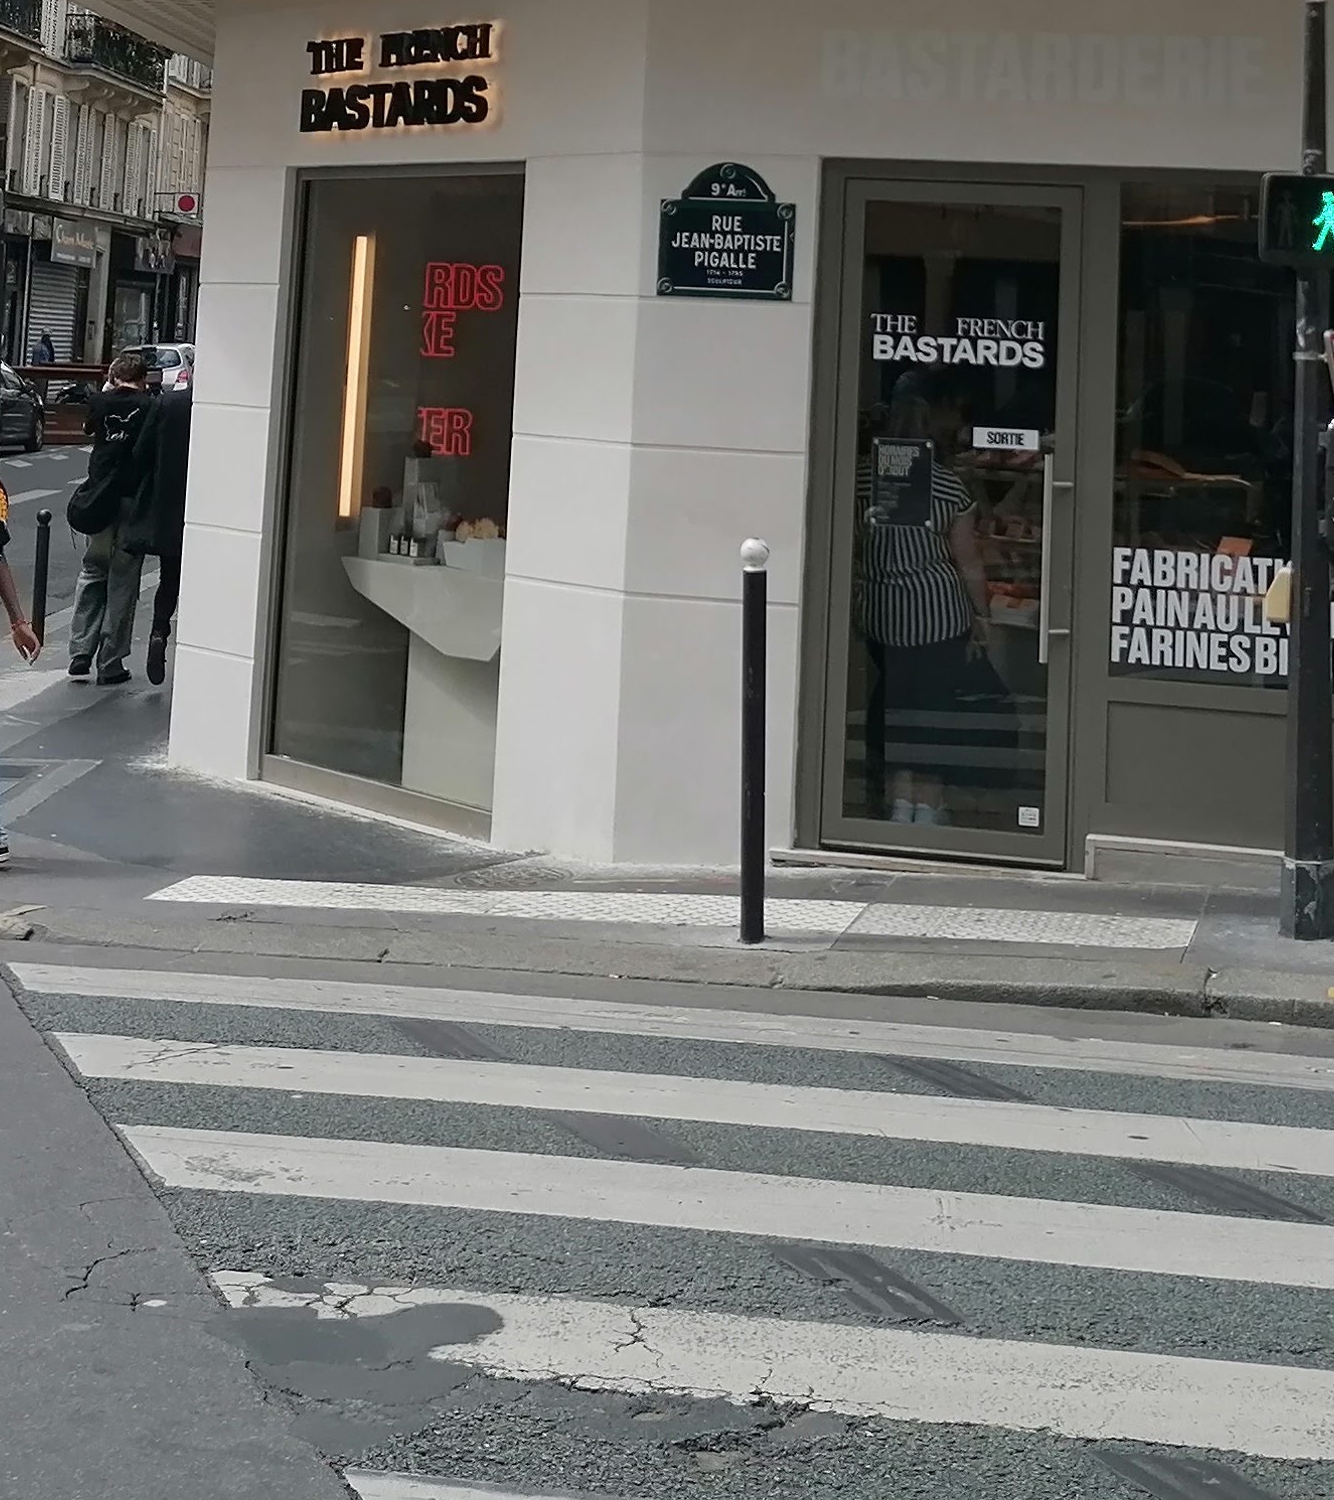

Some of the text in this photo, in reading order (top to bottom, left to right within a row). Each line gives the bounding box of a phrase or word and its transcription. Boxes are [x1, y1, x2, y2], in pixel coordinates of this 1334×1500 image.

[306, 23, 493, 75] THE FRENCH
[821, 30, 1265, 106] BASTARDERIE
[300, 75, 489, 132] BASTARDS
[712, 215, 742, 231] RUE
[671, 232, 782, 252] JEAN-BAPTISTE
[694, 251, 757, 269] PIGALLE
[870, 313, 1045, 340] THE FRENCH
[872, 334, 1045, 368] BASTARDS
[986, 431, 1025, 446] SORTIE
[1112, 586, 1189, 628] PAIN
[1193, 592, 1239, 633] AU
[1111, 624, 1252, 673] FARINES
